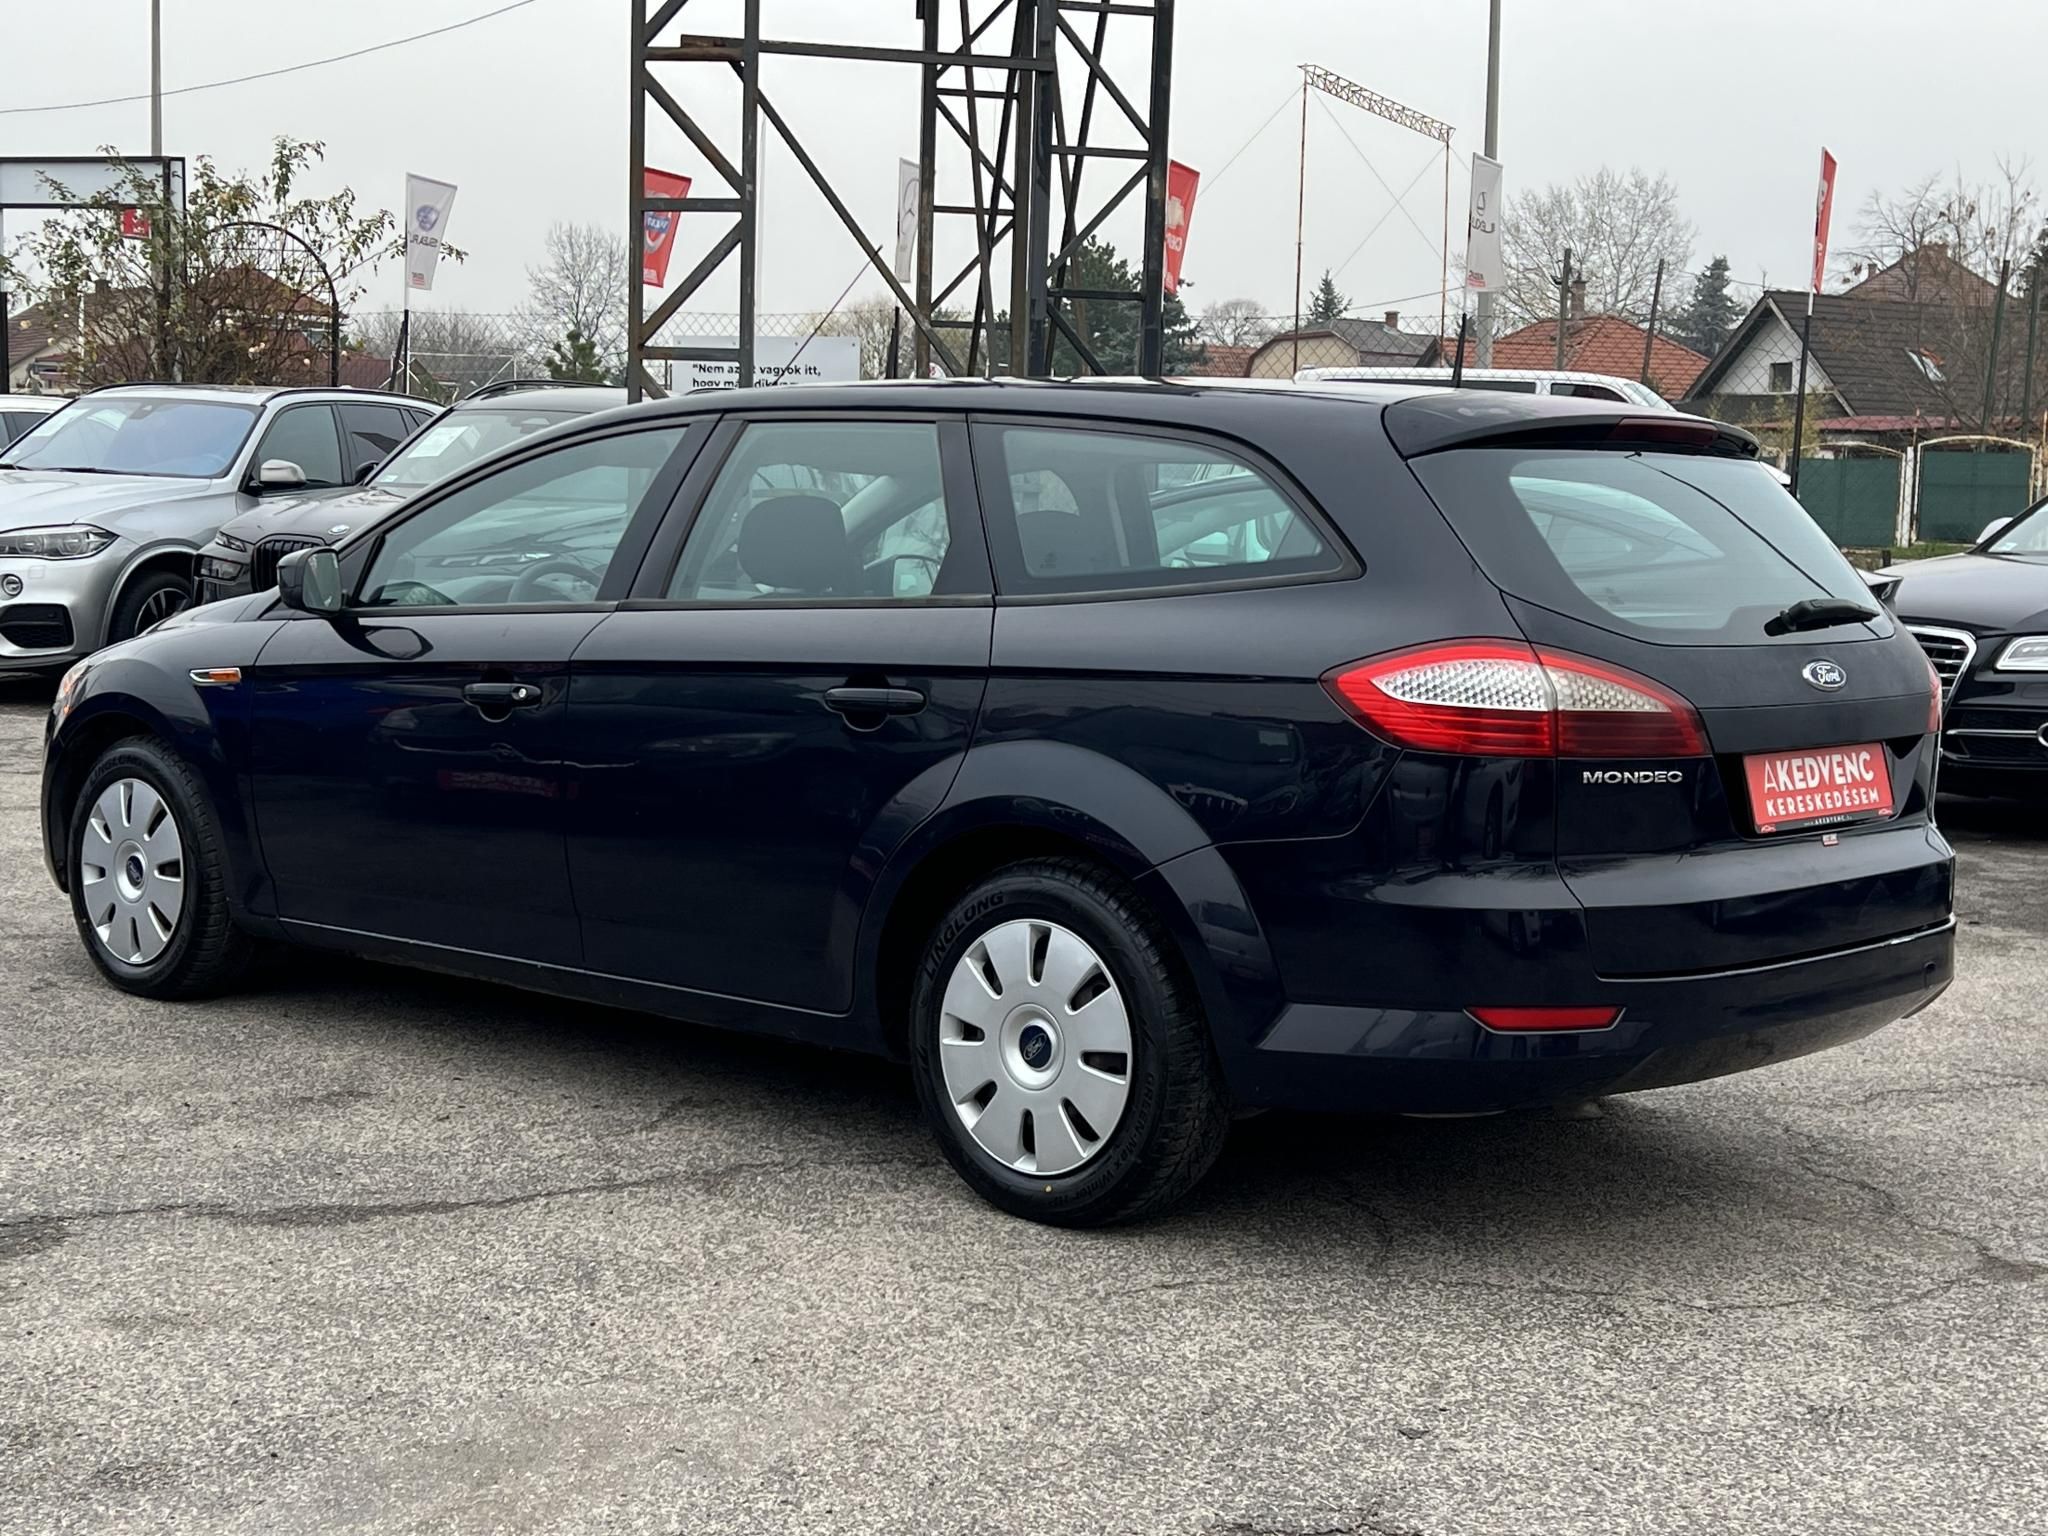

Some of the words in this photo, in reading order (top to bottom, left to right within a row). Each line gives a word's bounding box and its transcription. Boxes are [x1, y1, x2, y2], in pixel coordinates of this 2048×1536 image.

[760, 364, 801, 376] vagyok
[804, 364, 821, 376] itt,
[1816, 665, 1841, 685] Ford
[1583, 771, 1683, 784] MONDEO
[1764, 751, 1875, 794] AKEDVENC
[1766, 785, 1879, 817] KERESKEDÉSEM
[924, 891, 1005, 982] LINGLONG
